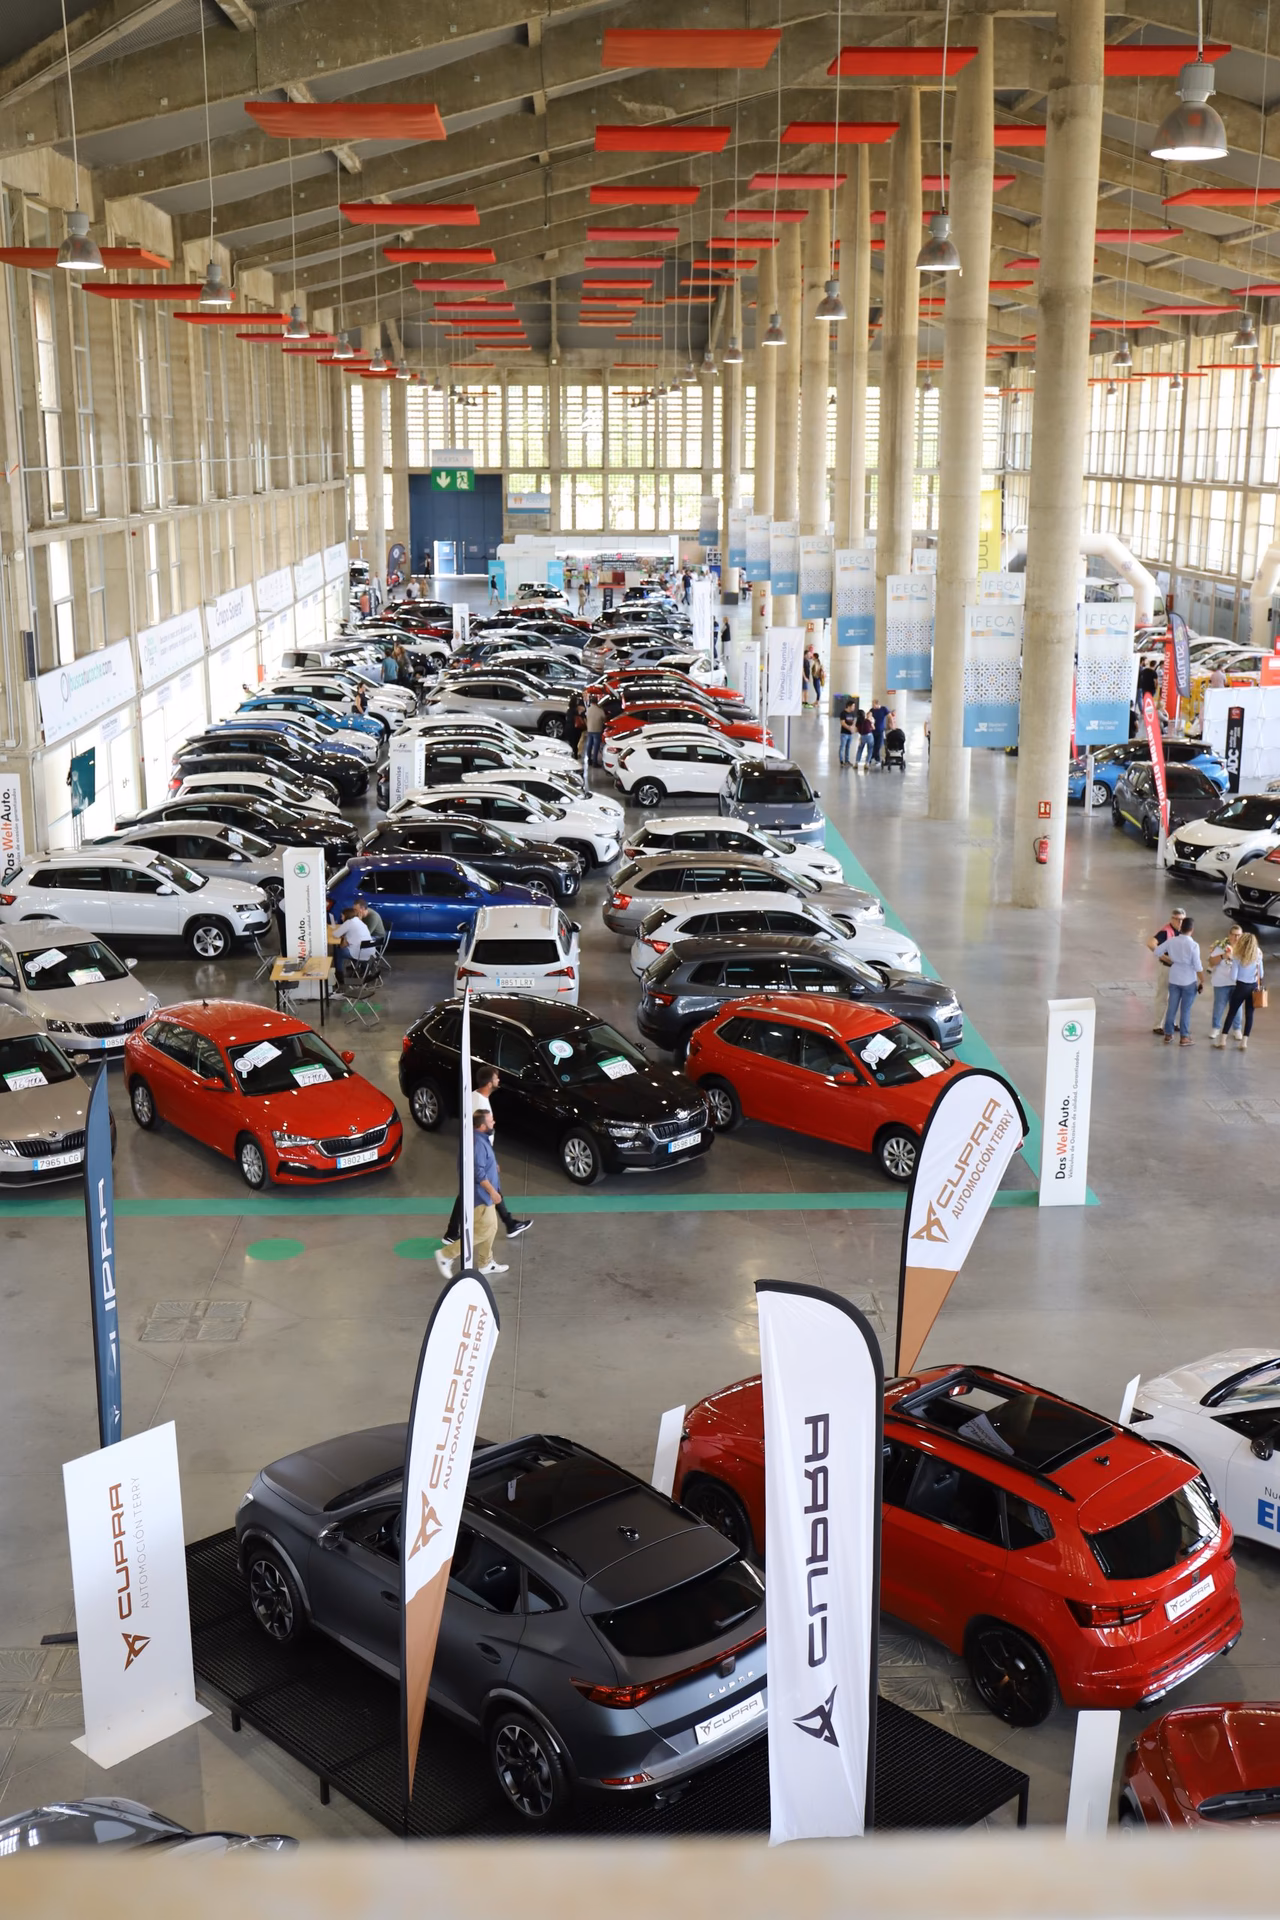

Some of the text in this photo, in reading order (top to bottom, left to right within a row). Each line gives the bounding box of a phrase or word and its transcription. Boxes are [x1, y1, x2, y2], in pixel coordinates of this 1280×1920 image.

[802, 541, 830, 549] IFECA
[839, 556, 870, 565] IFECA
[917, 556, 937, 564] IFEC
[891, 583, 928, 593] IFECA
[985, 580, 1020, 591] IFECA
[971, 615, 1015, 627] IFECA
[1085, 613, 1129, 625] IFECA
[779, 641, 788, 701] Hyundai Promise
[1227, 748, 1240, 775] ADC
[396, 766, 404, 793] Promise
[1, 788, 13, 851] WeltAuto.
[106, 1038, 124, 1047] 0850
[672, 1139, 689, 1151] 9596
[1055, 1095, 1070, 1180] Das WeltAuto.
[39, 1154, 79, 1169] 7965 LCG
[342, 1151, 376, 1166] 3802 LJP
[936, 1098, 1001, 1209] CUPRA
[951, 1109, 1014, 1220] AUTOMOCIÓN TERRY
[429, 1304, 478, 1489] CUPRA
[443, 1307, 488, 1490] AUTOMOCIÓN TERRY
[109, 1483, 132, 1620] CUPRA
[130, 1477, 150, 1609] AUTOMOCIÓN TERRY
[1179, 1582, 1211, 1608] CUPRA
[708, 1671, 754, 1699] CUPRA
[713, 1700, 758, 1729] CUPRA
